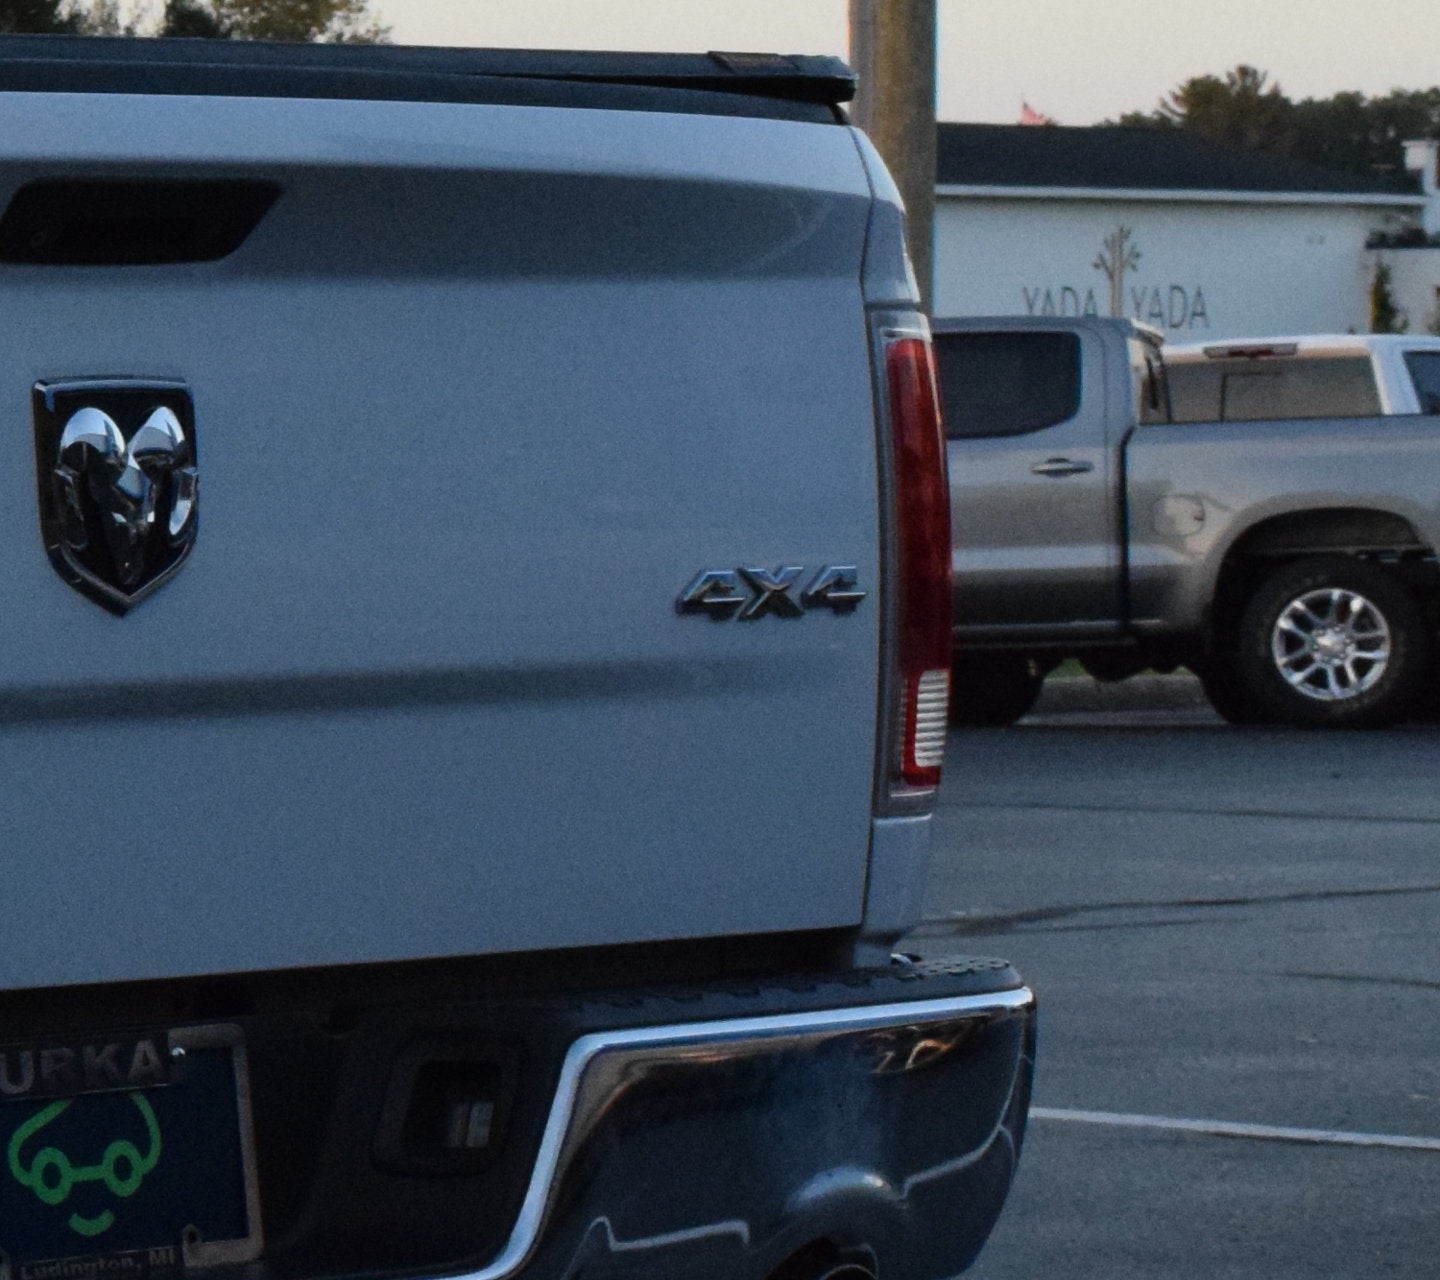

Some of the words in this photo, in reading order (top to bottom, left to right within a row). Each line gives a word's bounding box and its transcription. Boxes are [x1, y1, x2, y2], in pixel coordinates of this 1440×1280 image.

[1022, 285, 1099, 317] YADA
[1130, 283, 1211, 329] YADA
[148, 1248, 176, 1267] MI
